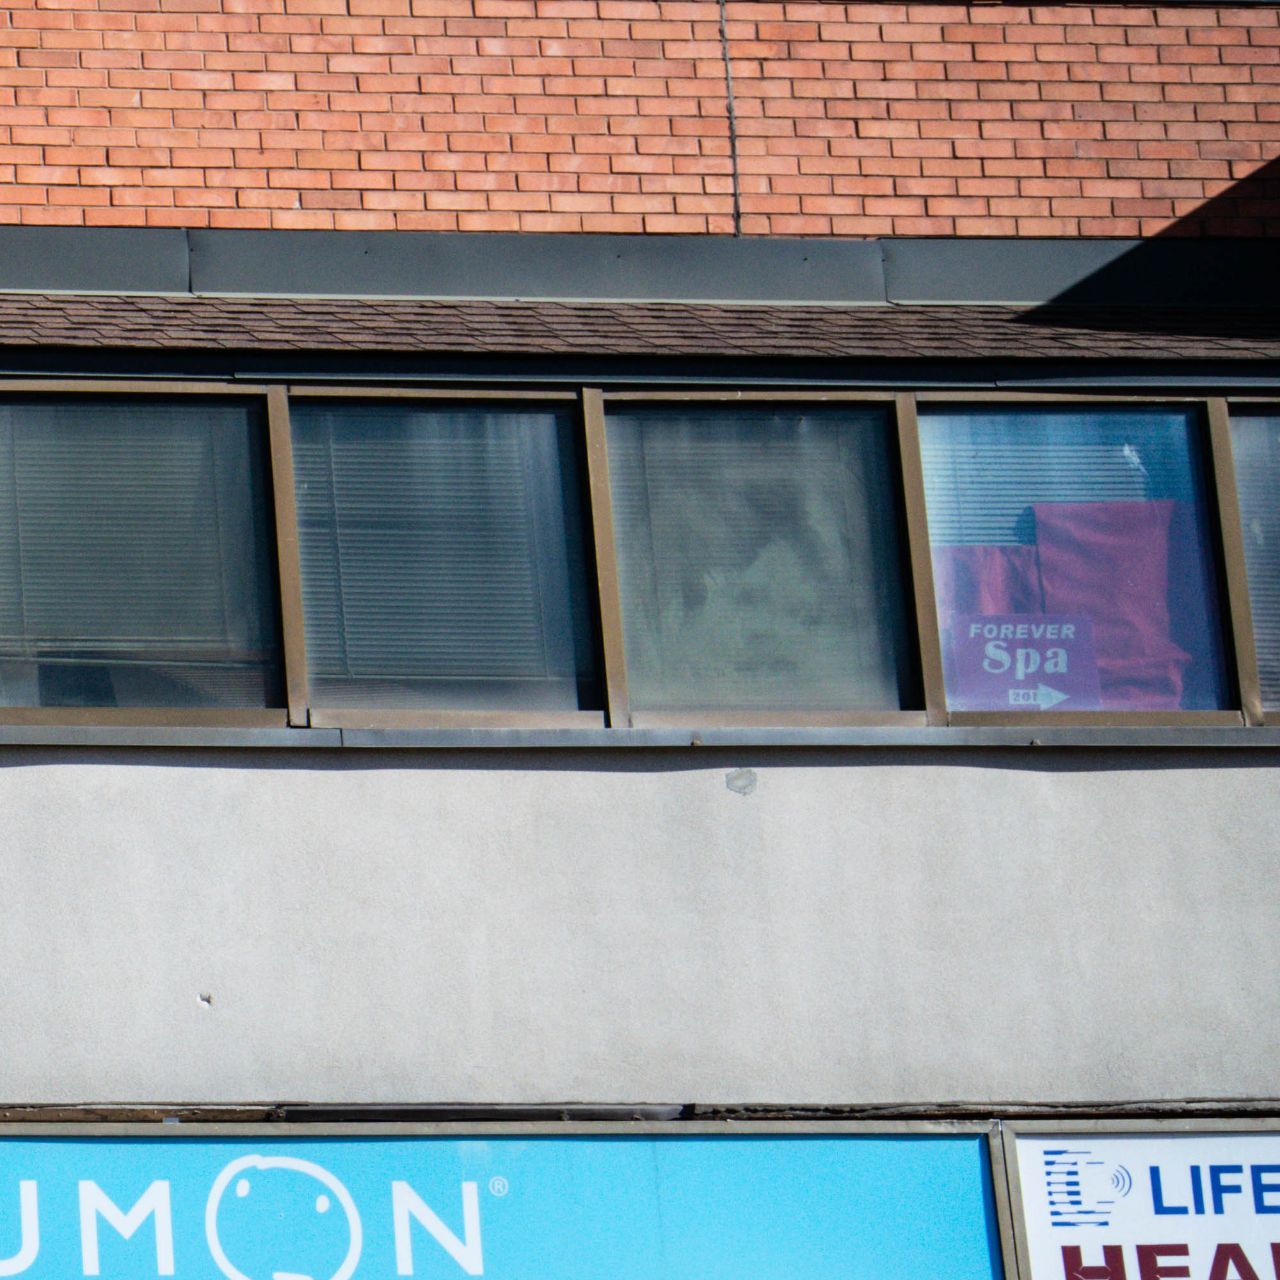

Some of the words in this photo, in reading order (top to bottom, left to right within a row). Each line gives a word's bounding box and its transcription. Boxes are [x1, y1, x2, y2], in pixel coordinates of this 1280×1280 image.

[969, 624, 1076, 640] FOREVER
[982, 641, 1068, 680] Spa
[1149, 1164, 1280, 1216] LIFE
